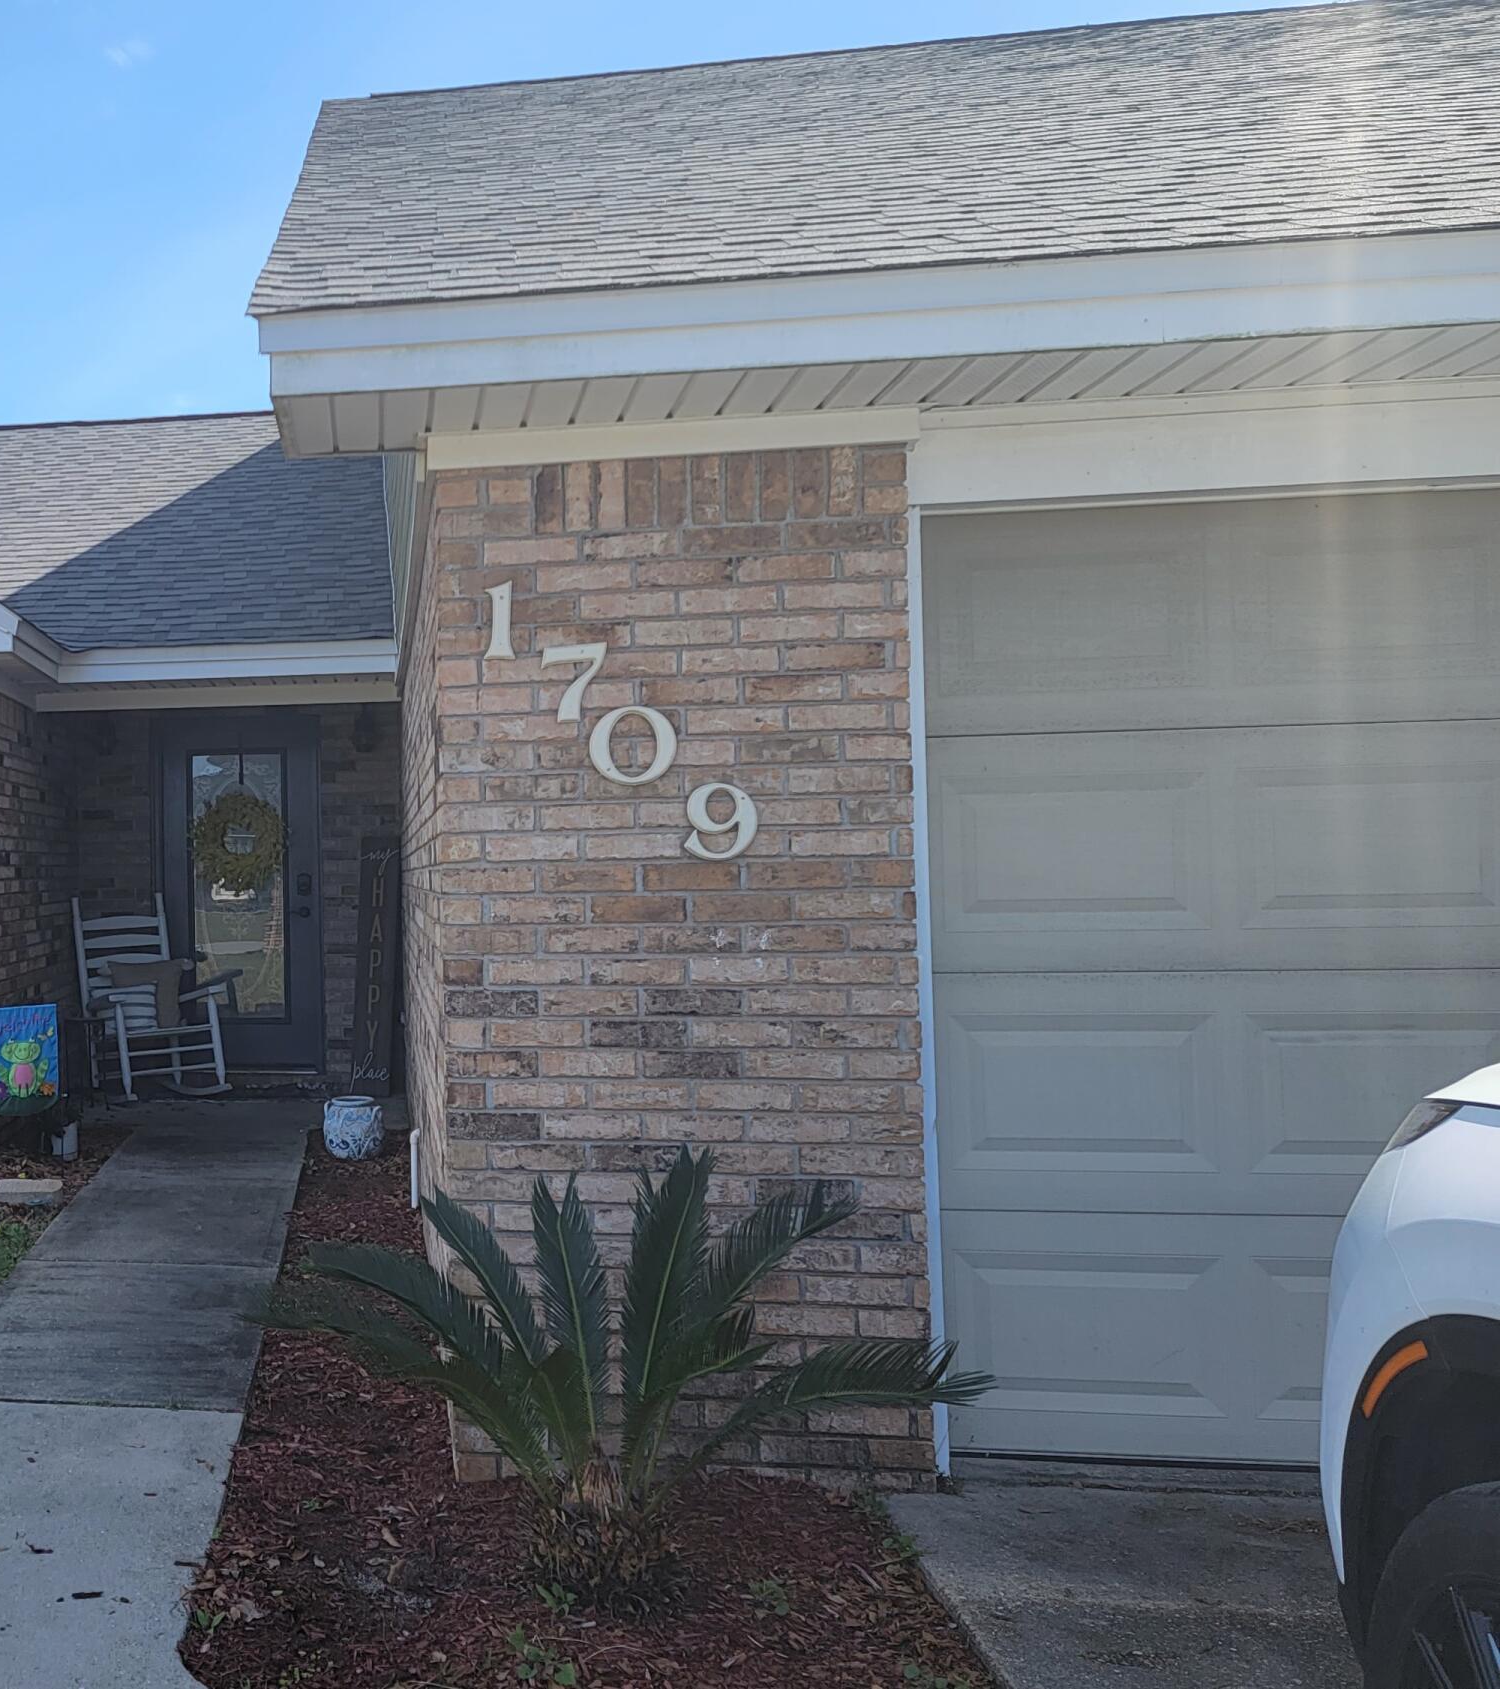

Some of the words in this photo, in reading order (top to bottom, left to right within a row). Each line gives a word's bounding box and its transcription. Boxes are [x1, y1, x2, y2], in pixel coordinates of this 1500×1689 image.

[484, 579, 758, 860] 1709
[361, 848, 400, 876] my
[366, 877, 385, 1050] HAPPY
[349, 1051, 389, 1094] place
